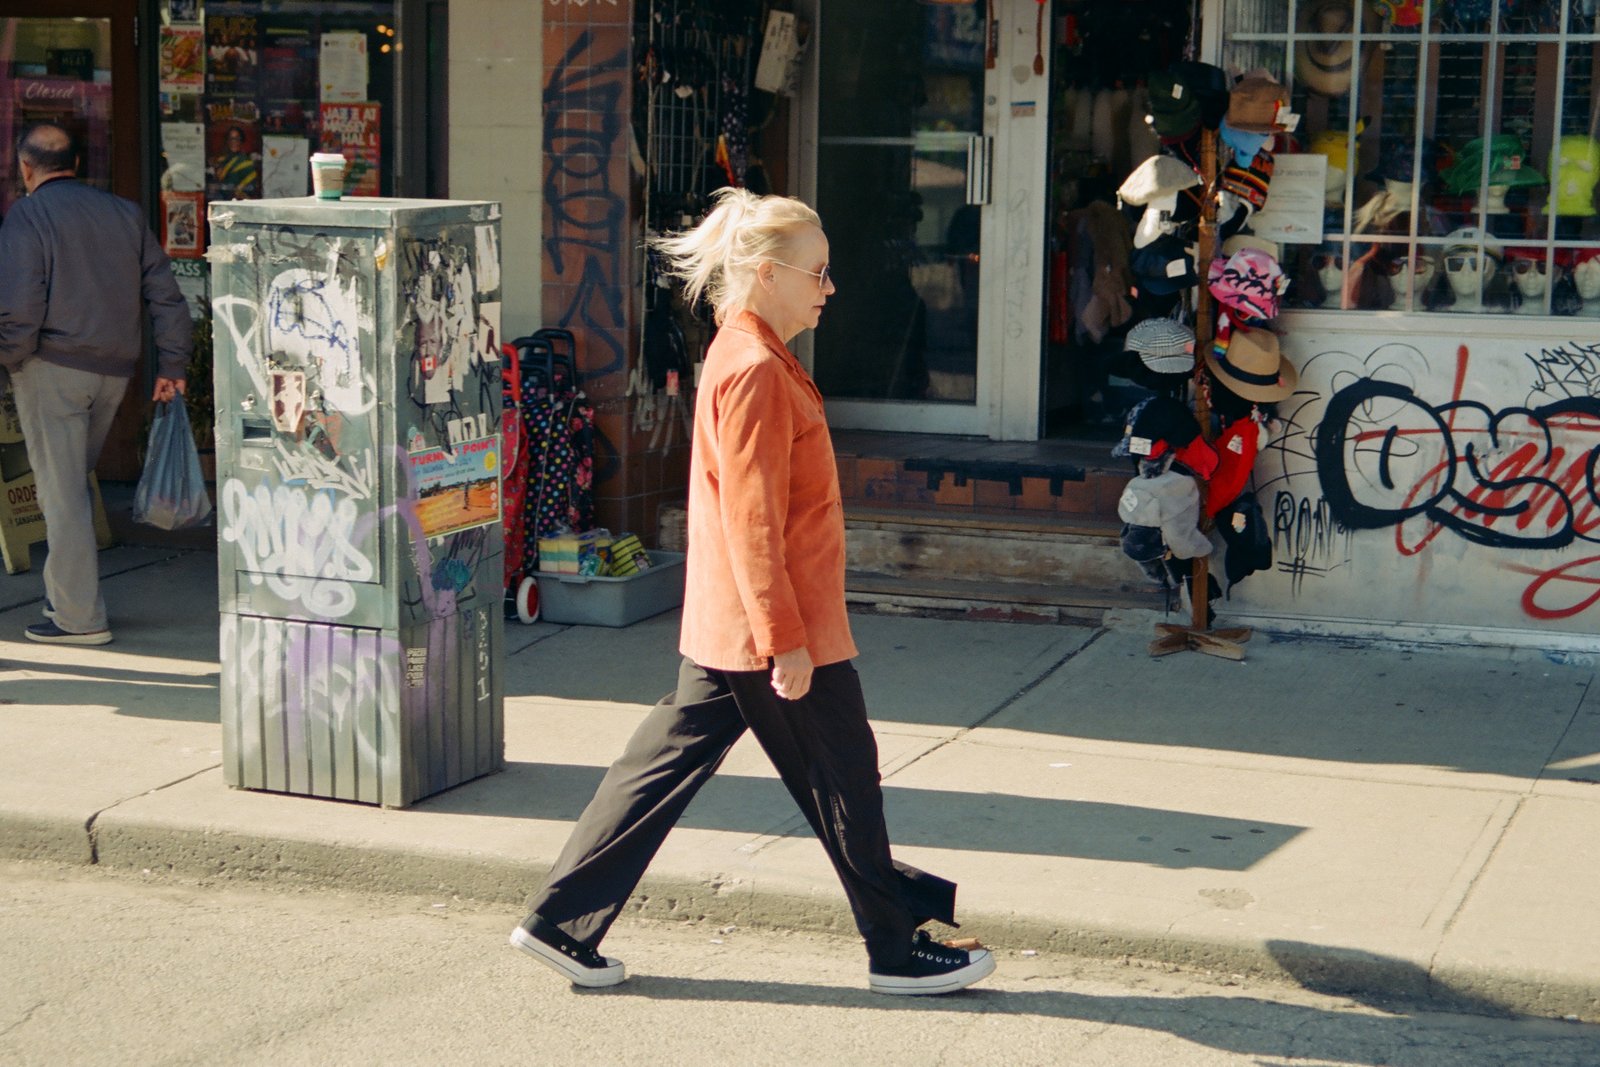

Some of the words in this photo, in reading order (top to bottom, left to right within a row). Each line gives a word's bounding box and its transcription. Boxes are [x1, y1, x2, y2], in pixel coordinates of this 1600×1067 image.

[26, 82, 76, 100] Closed
[170, 261, 201, 277] PASS
[463, 437, 497, 455] POINT
[8, 483, 38, 505] ORDE
